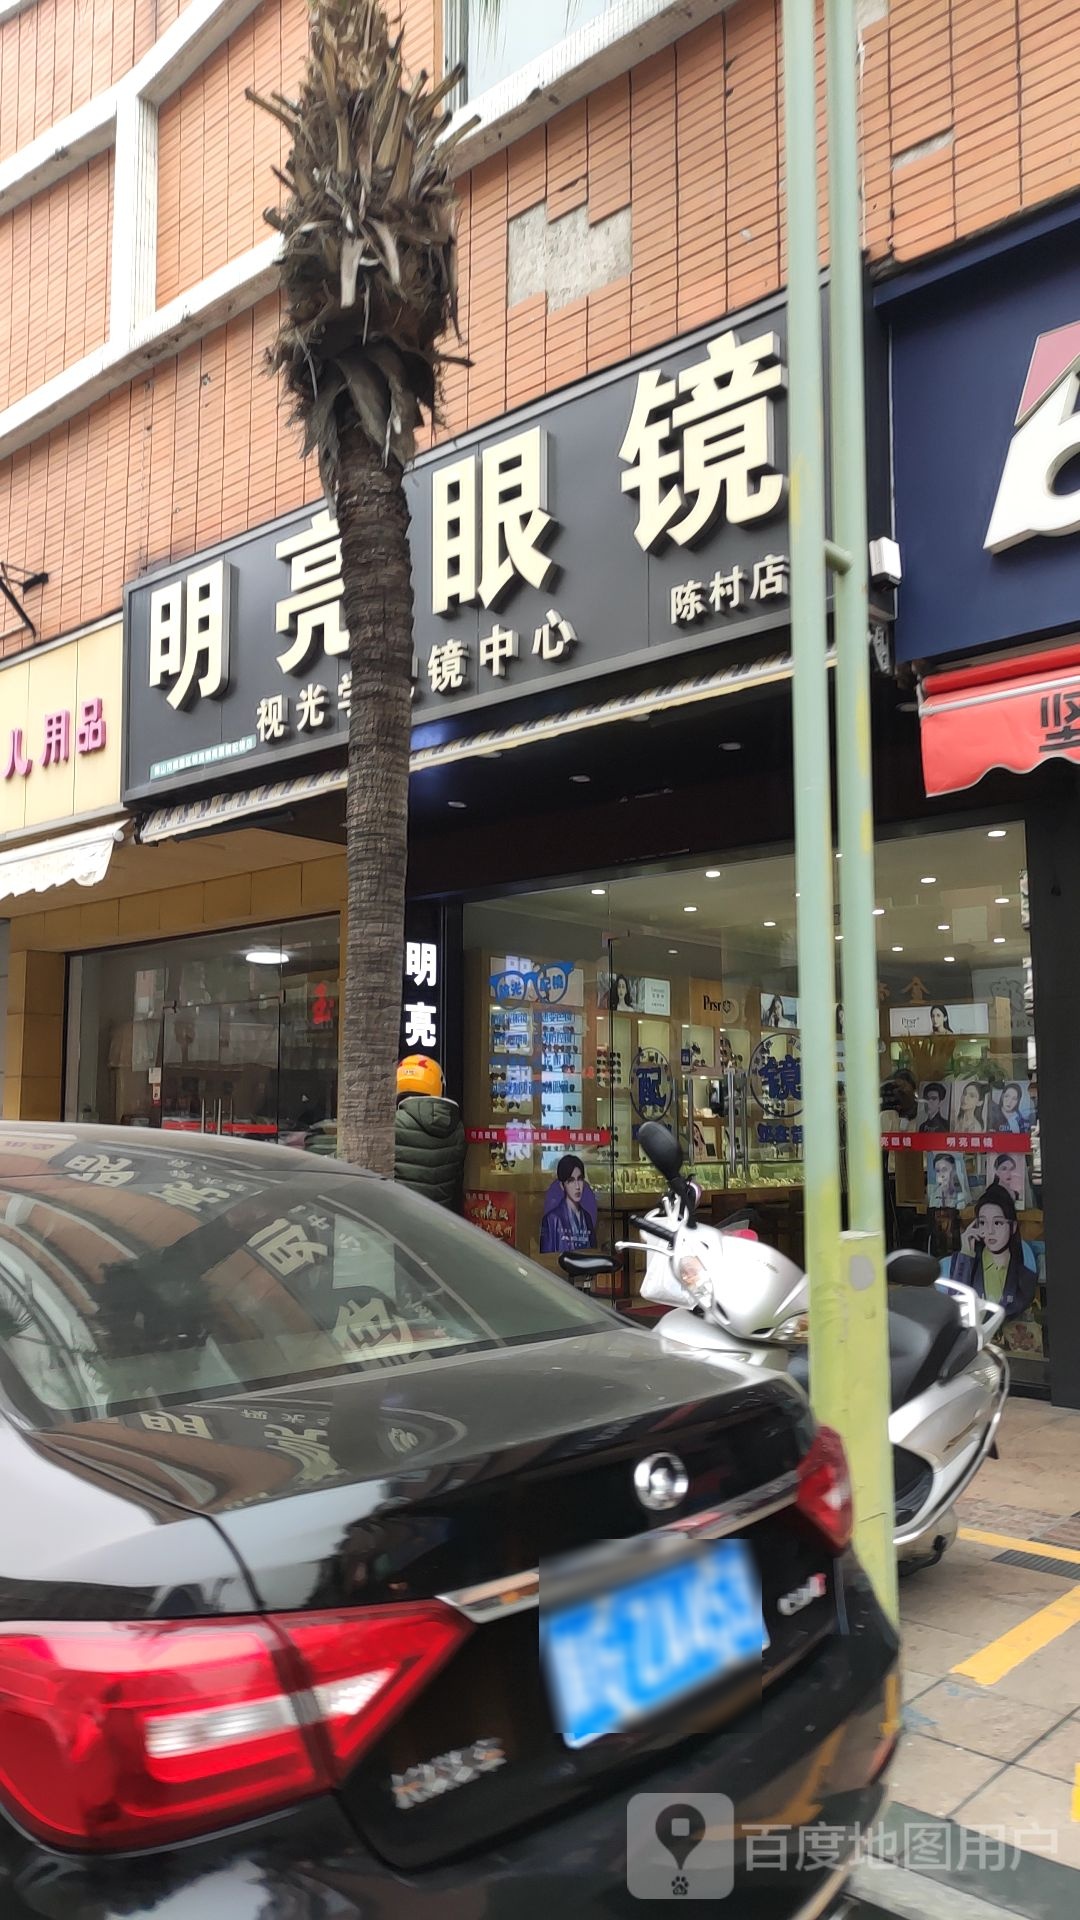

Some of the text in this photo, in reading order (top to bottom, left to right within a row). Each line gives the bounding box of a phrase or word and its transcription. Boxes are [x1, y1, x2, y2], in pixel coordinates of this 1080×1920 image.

[149, 330, 786, 710] 明亮眼镜
[671, 554, 788, 624] 陈村店
[256, 608, 577, 742] 视光镜中心
[2, 697, 106, 781] 儿用品
[404, 941, 437, 1048] 明亮
